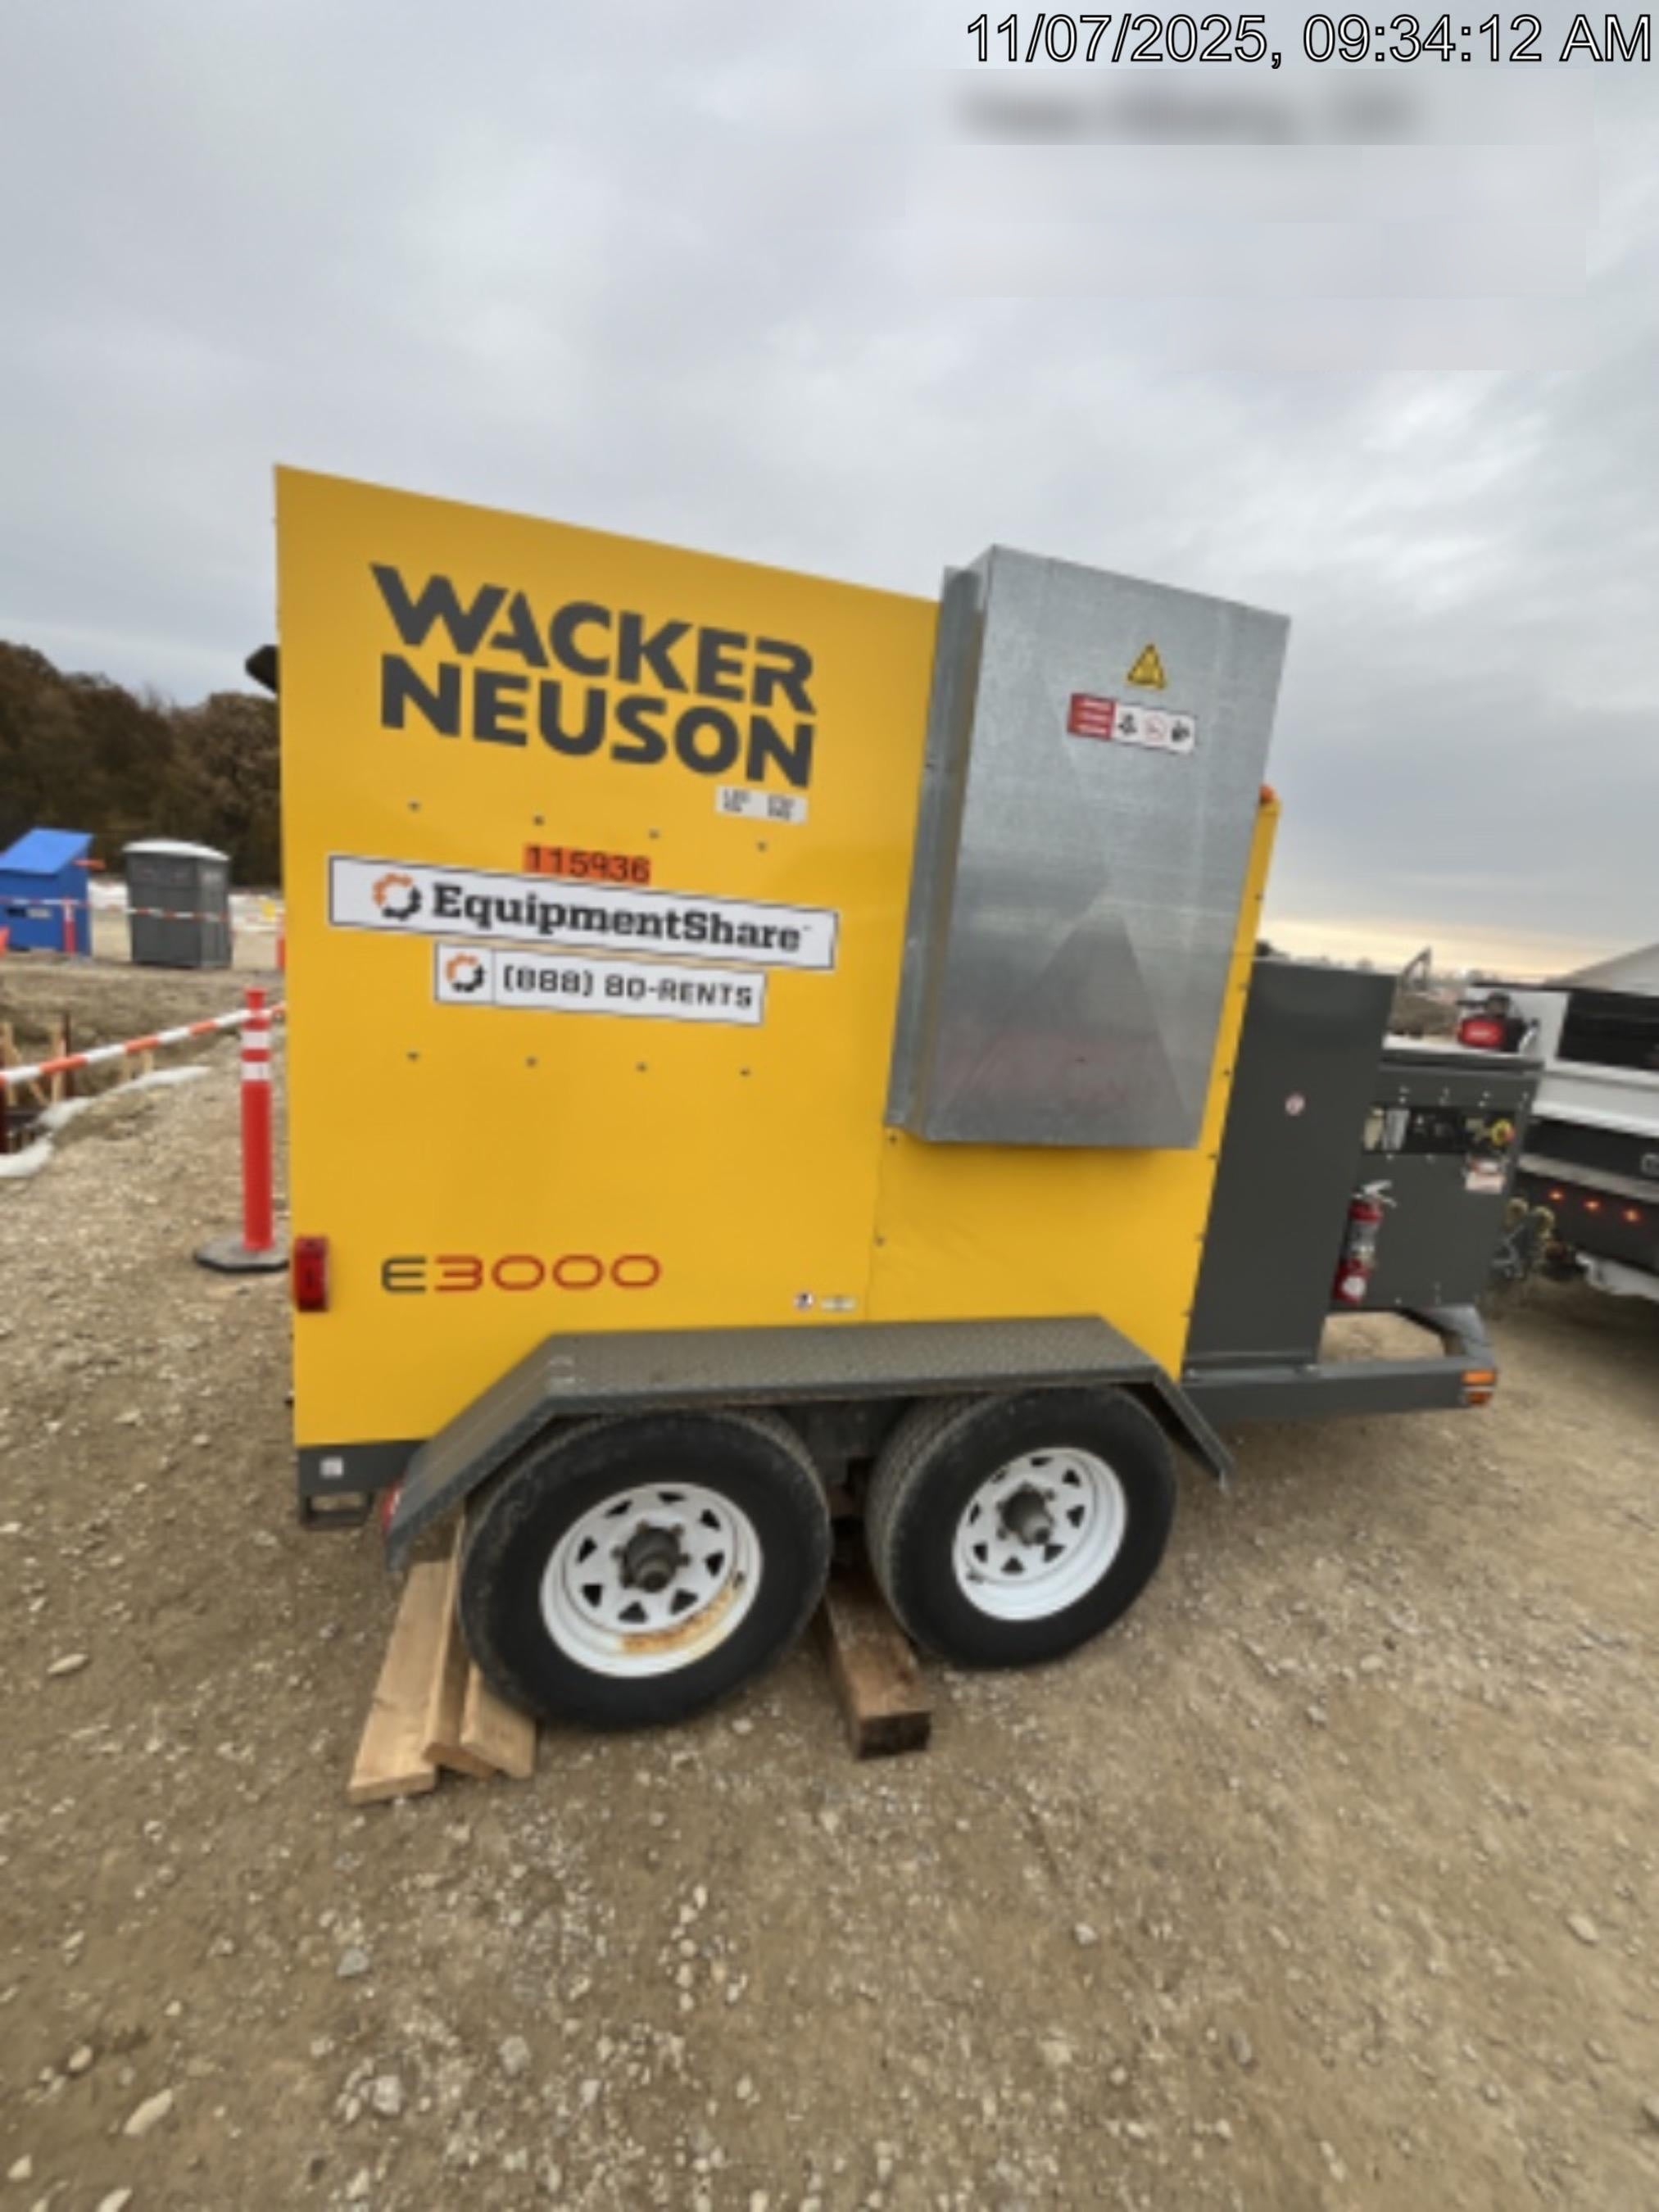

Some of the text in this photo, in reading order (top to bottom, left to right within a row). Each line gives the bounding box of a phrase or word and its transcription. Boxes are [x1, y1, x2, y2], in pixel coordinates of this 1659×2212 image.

[369, 562, 817, 716] WACKER
[380, 652, 814, 790] NEUSON
[526, 845, 651, 885] 115936
[431, 883, 801, 953] EquipmentShare
[381, 1254, 662, 1292] E3000
